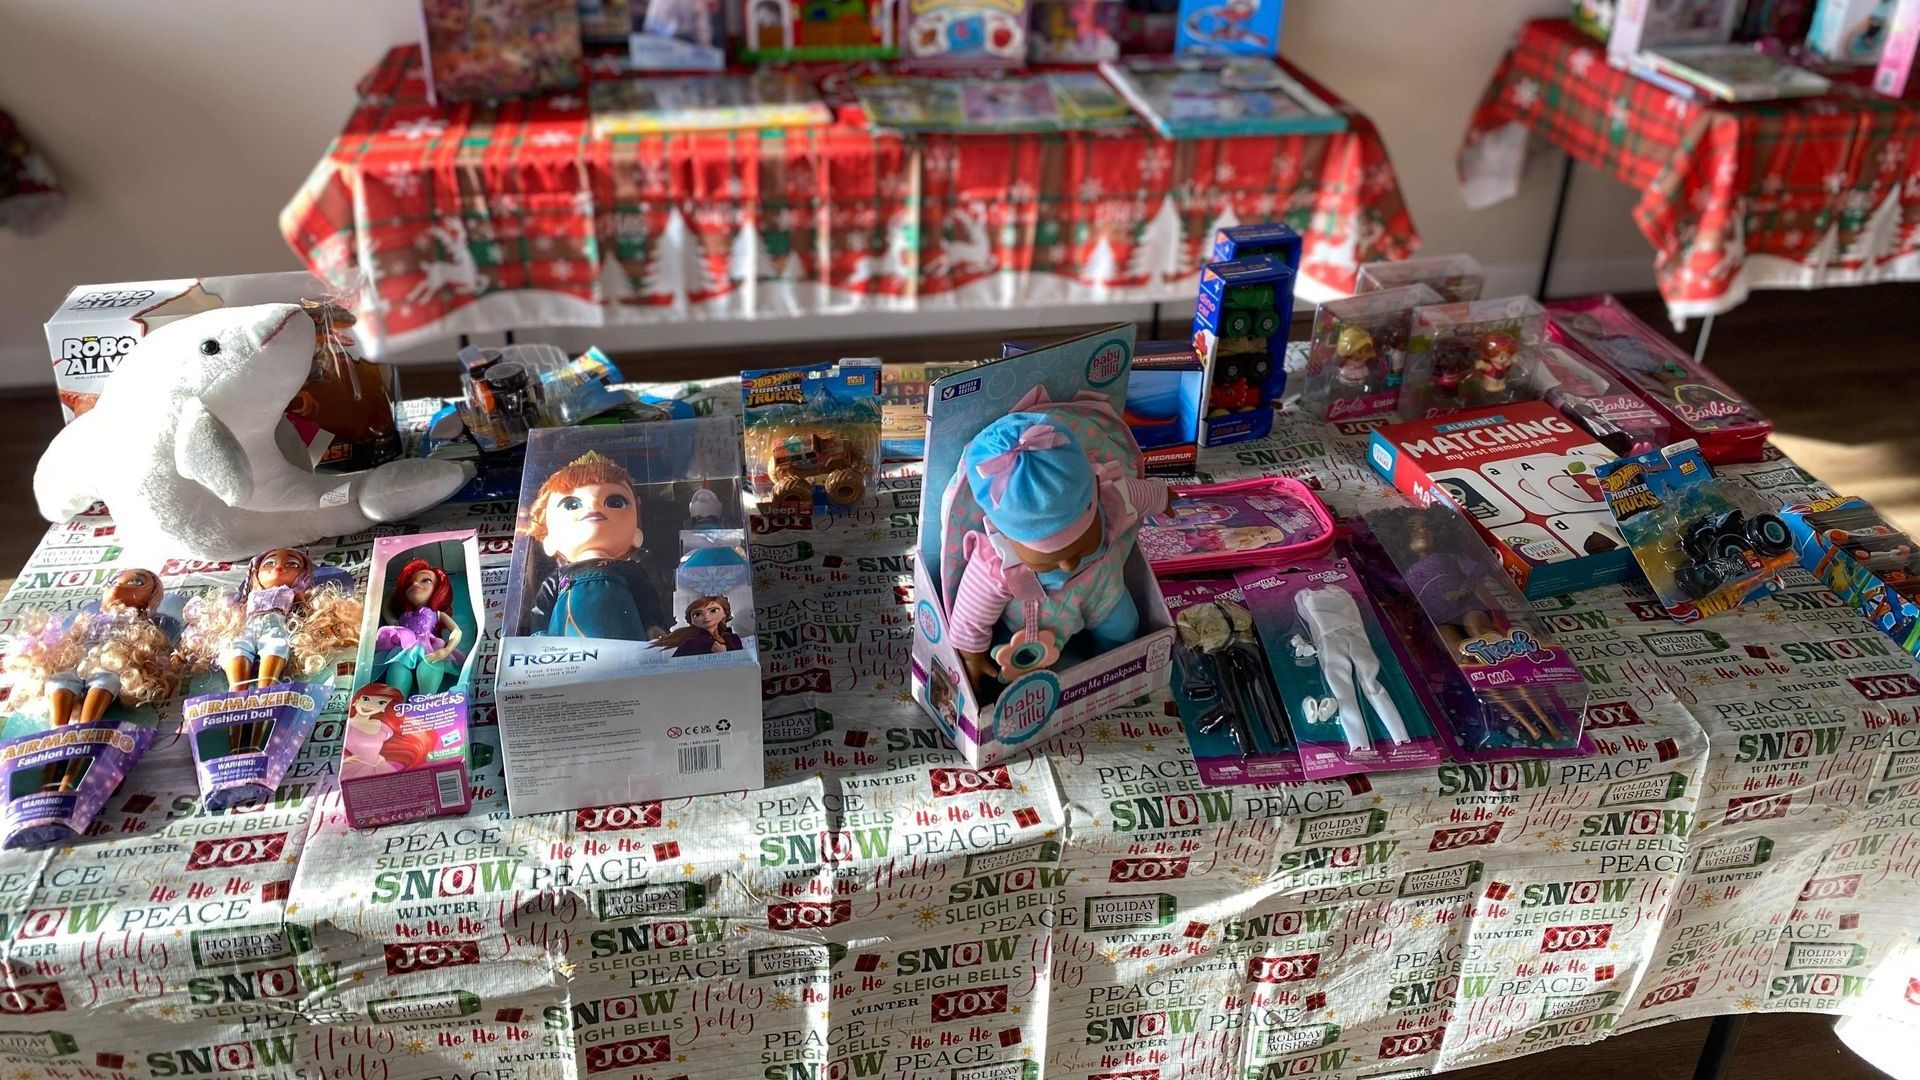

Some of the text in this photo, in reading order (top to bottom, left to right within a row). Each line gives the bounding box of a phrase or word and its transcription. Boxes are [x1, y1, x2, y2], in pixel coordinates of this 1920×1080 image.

[68, 299, 145, 310] ALIVE
[78, 290, 155, 303] ROBO
[1199, 293, 1215, 312] dino
[1198, 304, 1209, 317] car
[63, 337, 137, 359] ROBO
[65, 356, 123, 376] ALIV
[1093, 350, 1120, 368] baby
[1101, 362, 1119, 378] lilly
[751, 384, 800, 394] MONSTER
[753, 377, 773, 388] HOT
[959, 381, 977, 390] SAFETY
[959, 386, 976, 395] TESTED
[745, 391, 803, 406] TRUCKS
[1589, 397, 1645, 413] Barbie
[1675, 401, 1741, 421] Barbie
[1211, 423, 1251, 436] dino car
[1447, 417, 1497, 431] ALPHABET
[1401, 417, 1574, 459] MATCHING
[1148, 453, 1192, 462] MEGASAUR
[1236, 442, 1328, 466] SNOW
[1446, 436, 1558, 461] my first memory game
[1520, 462, 1536, 472] A
[1608, 474, 1624, 491] HOT
[1611, 484, 1649, 500] MONSTER
[764, 505, 795, 516] Jeep
[1611, 493, 1663, 517] TRUCKS
[1524, 540, 1557, 555] CHUCKLE
[1652, 635, 1704, 646] HOLIDAY
[1780, 636, 1890, 665] SNOW
[508, 650, 599, 668] FROZEN
[1680, 655, 1742, 667] WINTER
[766, 673, 824, 695] JOY
[1063, 661, 1142, 701] Carry Me Backpack
[1488, 670, 1515, 684] MIA
[1866, 678, 1918, 697] JOY
[394, 692, 464, 717] PRINCESS
[1003, 685, 1045, 720] baby
[202, 709, 274, 727] Fashion Doll
[1018, 705, 1047, 731] lilly
[1727, 709, 1846, 732] SLEIGH BELLS
[765, 738, 834, 757] WINTER
[1735, 726, 1846, 764] SNOW
[17, 745, 91, 767] Fashion Doll
[217, 760, 257, 770] WARNING:
[984, 752, 997, 764] 3+
[1559, 757, 1654, 786] PEACE
[1752, 761, 1809, 774] WINTER
[846, 773, 917, 789] WINTER
[1437, 759, 1551, 799] SNOW
[1612, 778, 1668, 793] HOLIDAY
[1109, 789, 1234, 832] SNOW
[1244, 789, 1346, 821] PEACE
[583, 807, 651, 827] JOY
[1308, 815, 1368, 834] HOLIDAY
[384, 826, 504, 855] PEACE
[904, 822, 1015, 857] PEACE
[1309, 824, 1363, 841] WISHES
[1435, 825, 1495, 850] JOY
[97, 844, 179, 860] WINTER
[198, 839, 275, 865] JOY
[759, 827, 893, 867] SNOW
[375, 845, 528, 870] SLEIGH BELLS
[530, 857, 649, 890] PEACE
[785, 867, 860, 879] WINTER
[1116, 860, 1183, 881] JOY
[1410, 867, 1467, 883] HOLIDAY
[148, 877, 254, 903] Ho Ho Ho
[370, 859, 524, 904] SNOW
[949, 866, 1075, 904] SNOW
[610, 888, 681, 906] HOLIDAY
[1520, 878, 1636, 909] SNOW
[116, 899, 251, 932] PEACE
[396, 901, 480, 919] WINTER
[498, 889, 581, 928] Holly
[614, 900, 679, 914] WISHES
[1094, 899, 1156, 914] HOLIDAY
[1513, 906, 1629, 926] SLEIGH BELLS
[395, 917, 486, 937] Ho Ho Ho
[978, 906, 1079, 935] PEACE
[1097, 911, 1153, 924] WISHES
[1223, 905, 1339, 945] SNOW
[203, 932, 285, 955] HOLIDAY
[589, 917, 730, 959] SNOW
[1105, 931, 1173, 944] WINTER
[1546, 927, 1607, 950] JOY
[79, 934, 170, 970] Holly
[210, 943, 284, 960] WISHES
[395, 944, 471, 970] JOY
[588, 944, 727, 974] SLEIGH BELLS
[896, 935, 1021, 977] SNOW
[1797, 949, 1849, 959] HOLIDAY
[1797, 957, 1843, 966] WISHES
[629, 958, 742, 989] PEACE
[1252, 958, 1314, 980] JOY
[186, 961, 342, 1004] SNOW
[1498, 977, 1588, 997] PEACE
[691, 982, 767, 1012] Holly
[938, 990, 1000, 1018] JOY
[542, 988, 680, 1031] SNOW
[763, 1021, 867, 1049] PEACE
[1085, 1008, 1201, 1046] SNOW
[145, 1035, 299, 1078] SNOW
[593, 1039, 663, 1067] JOY
